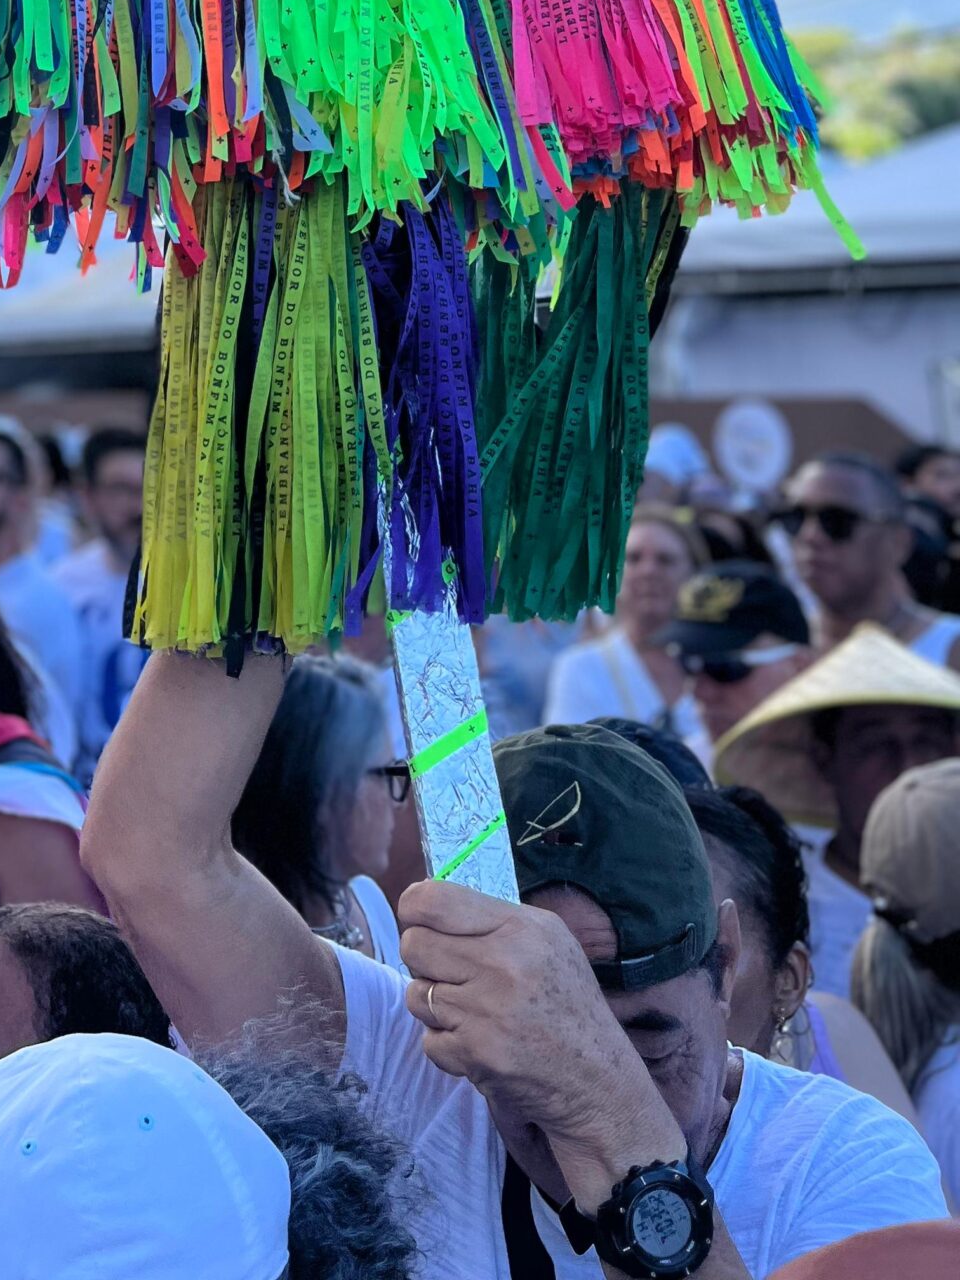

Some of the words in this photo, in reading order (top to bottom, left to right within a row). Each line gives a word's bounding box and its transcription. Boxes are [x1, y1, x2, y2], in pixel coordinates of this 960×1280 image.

[289, 218, 307, 291] SENHOR
[230, 231, 247, 305] SENHOR
[284, 303, 296, 326] DO
[356, 277, 371, 346] SENHOR
[420, 304, 431, 328] DO
[222, 315, 235, 339] DO
[339, 349, 350, 374] DO
[364, 356, 375, 379] DO
[441, 359, 449, 383] DO
[272, 339, 290, 413] BONFIM
[576, 374, 588, 396] DO
[627, 374, 637, 395] DO
[206, 352, 228, 425] BONFIM
[267, 426, 277, 448] DA
[200, 438, 210, 461] DA
[279, 410, 289, 531] LEMBRANÇA
[462, 421, 472, 443] DA
[467, 456, 478, 518] BAHIA
